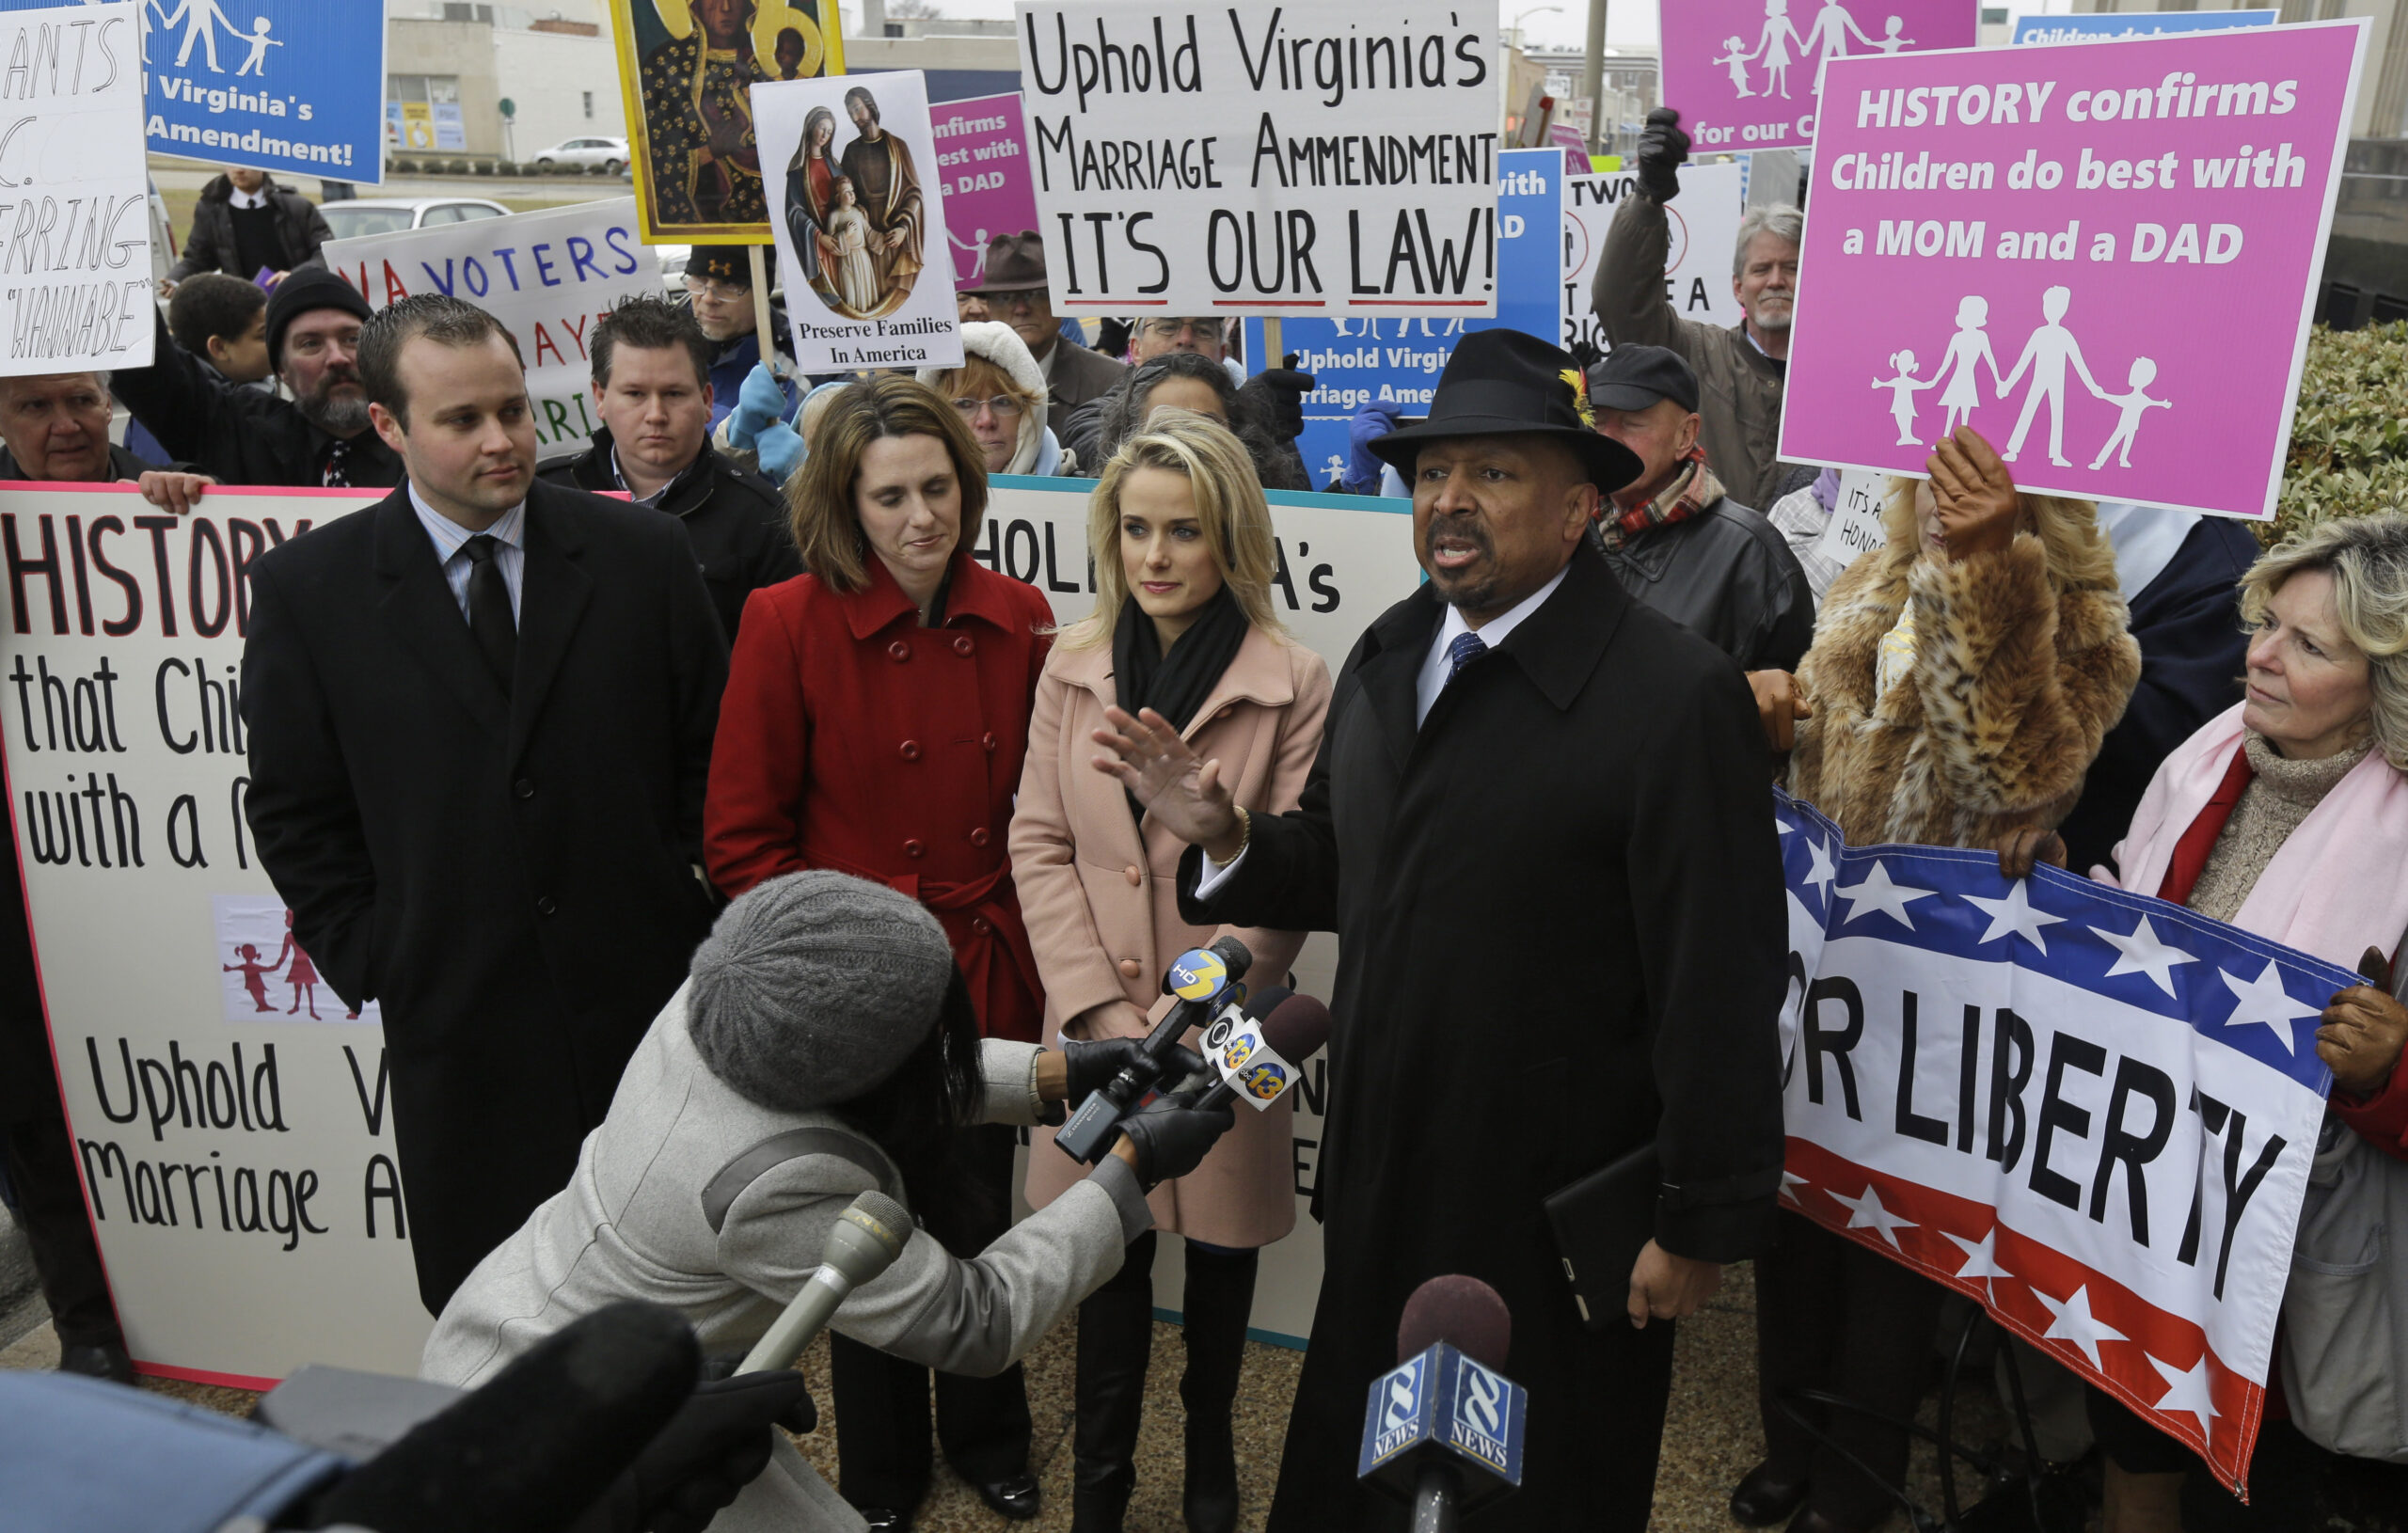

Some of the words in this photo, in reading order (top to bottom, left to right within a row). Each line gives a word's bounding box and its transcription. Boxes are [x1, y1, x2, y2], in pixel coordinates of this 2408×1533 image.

[1025, 11, 1202, 113] Uphold
[1228, 8, 1487, 108] Virginia's
[158, 74, 313, 121] Virginia's
[1856, 81, 2057, 129] HISTORY
[2065, 71, 2298, 123] confirms
[146, 114, 353, 167] Amendment!
[932, 115, 1006, 138] nfirms
[973, 138, 1020, 161] with
[1693, 121, 1735, 145] for
[1742, 122, 1789, 141] our
[1035, 115, 1222, 191] MARRIAGE
[1251, 112, 1497, 187] AMMENDMENT
[1830, 150, 1995, 191] Children
[2006, 150, 2064, 191] do
[2075, 148, 2178, 191] best
[2193, 142, 2306, 188] with
[942, 182, 954, 196] a
[958, 171, 1006, 194] DAD
[421, 226, 638, 298] VOTERS
[1057, 211, 1170, 294] IT'S
[1207, 209, 1323, 294] OUR
[1348, 207, 1494, 294] LAW!
[1843, 228, 1864, 255] a
[1876, 219, 1987, 259] MOM
[1995, 220, 2081, 261] and
[2089, 232, 2115, 262] a
[2130, 222, 2245, 265] DAD
[1687, 277, 1710, 311] A
[799, 323, 872, 340] Preserve
[876, 317, 953, 337] Families
[830, 347, 848, 364] In
[853, 345, 927, 363] America
[1293, 347, 1380, 375] Uphold
[1386, 346, 1453, 374] Virgi
[1378, 384, 1437, 404] Ame
[1848, 482, 1870, 514] IT'S
[1, 513, 313, 639] HISTOR
[974, 518, 1098, 593] HOL
[9, 654, 127, 753] that
[155, 656, 246, 755] Chi
[24, 771, 145, 869] with
[167, 794, 209, 869] a
[1173, 964, 1196, 985] HD
[1226, 1038, 1251, 1069] 13
[86, 1036, 291, 1142] Uphold
[1240, 1069, 1253, 1081] abc
[1247, 1067, 1285, 1100] 13
[1894, 989, 2288, 1304] LIBERTY
[77, 1137, 328, 1252] Marriage
[1372, 1418, 1419, 1461] NEWS
[1450, 1420, 1508, 1468] NEWS
